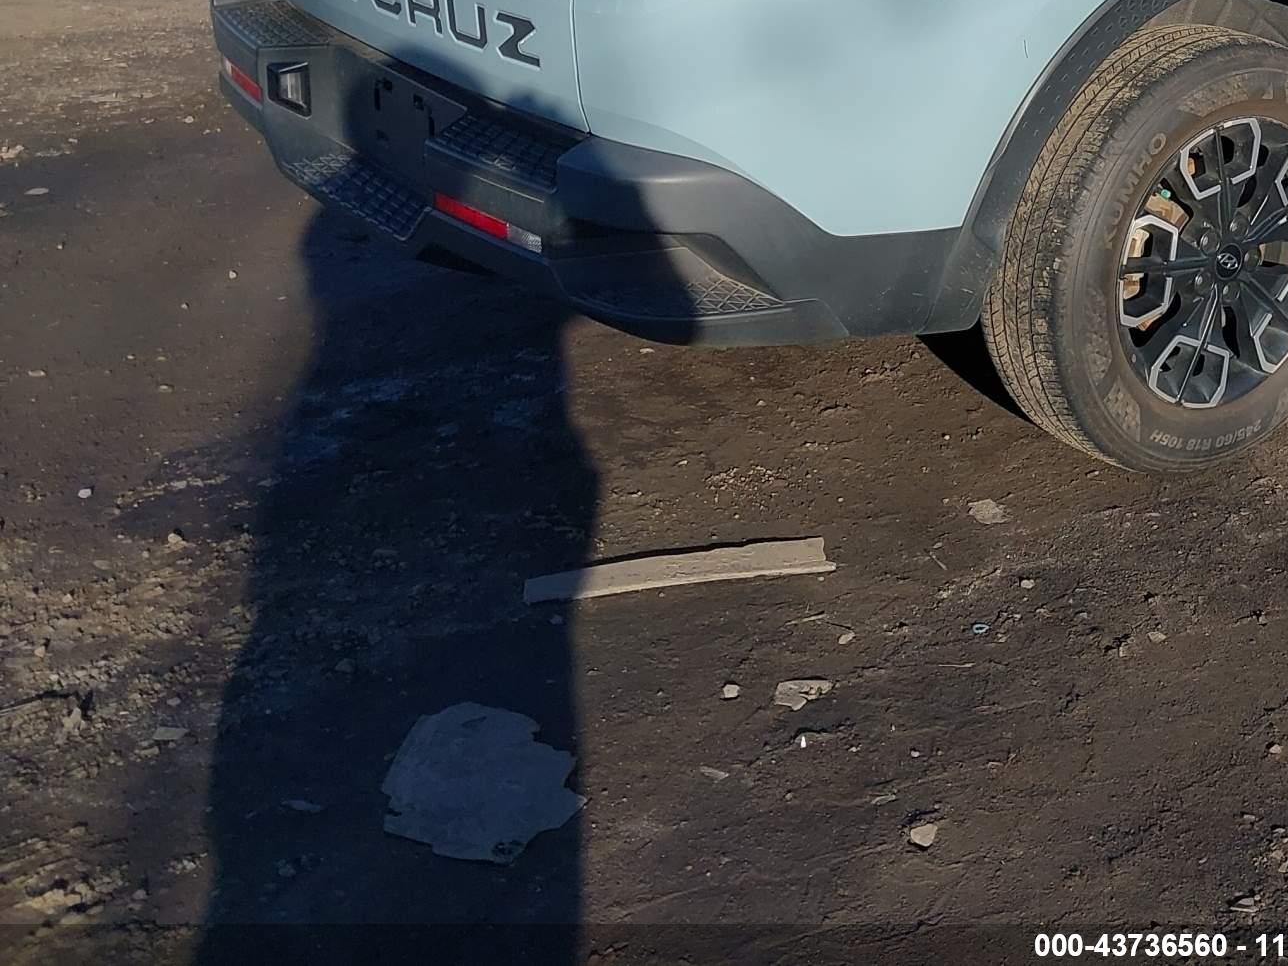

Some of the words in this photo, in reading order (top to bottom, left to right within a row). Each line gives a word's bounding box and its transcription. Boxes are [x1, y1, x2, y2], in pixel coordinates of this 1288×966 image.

[1103, 132, 1167, 250] KUMHO
[1149, 429, 1183, 449] 105H
[1185, 438, 1212, 451] R18
[1215, 418, 1262, 448] 245/60
